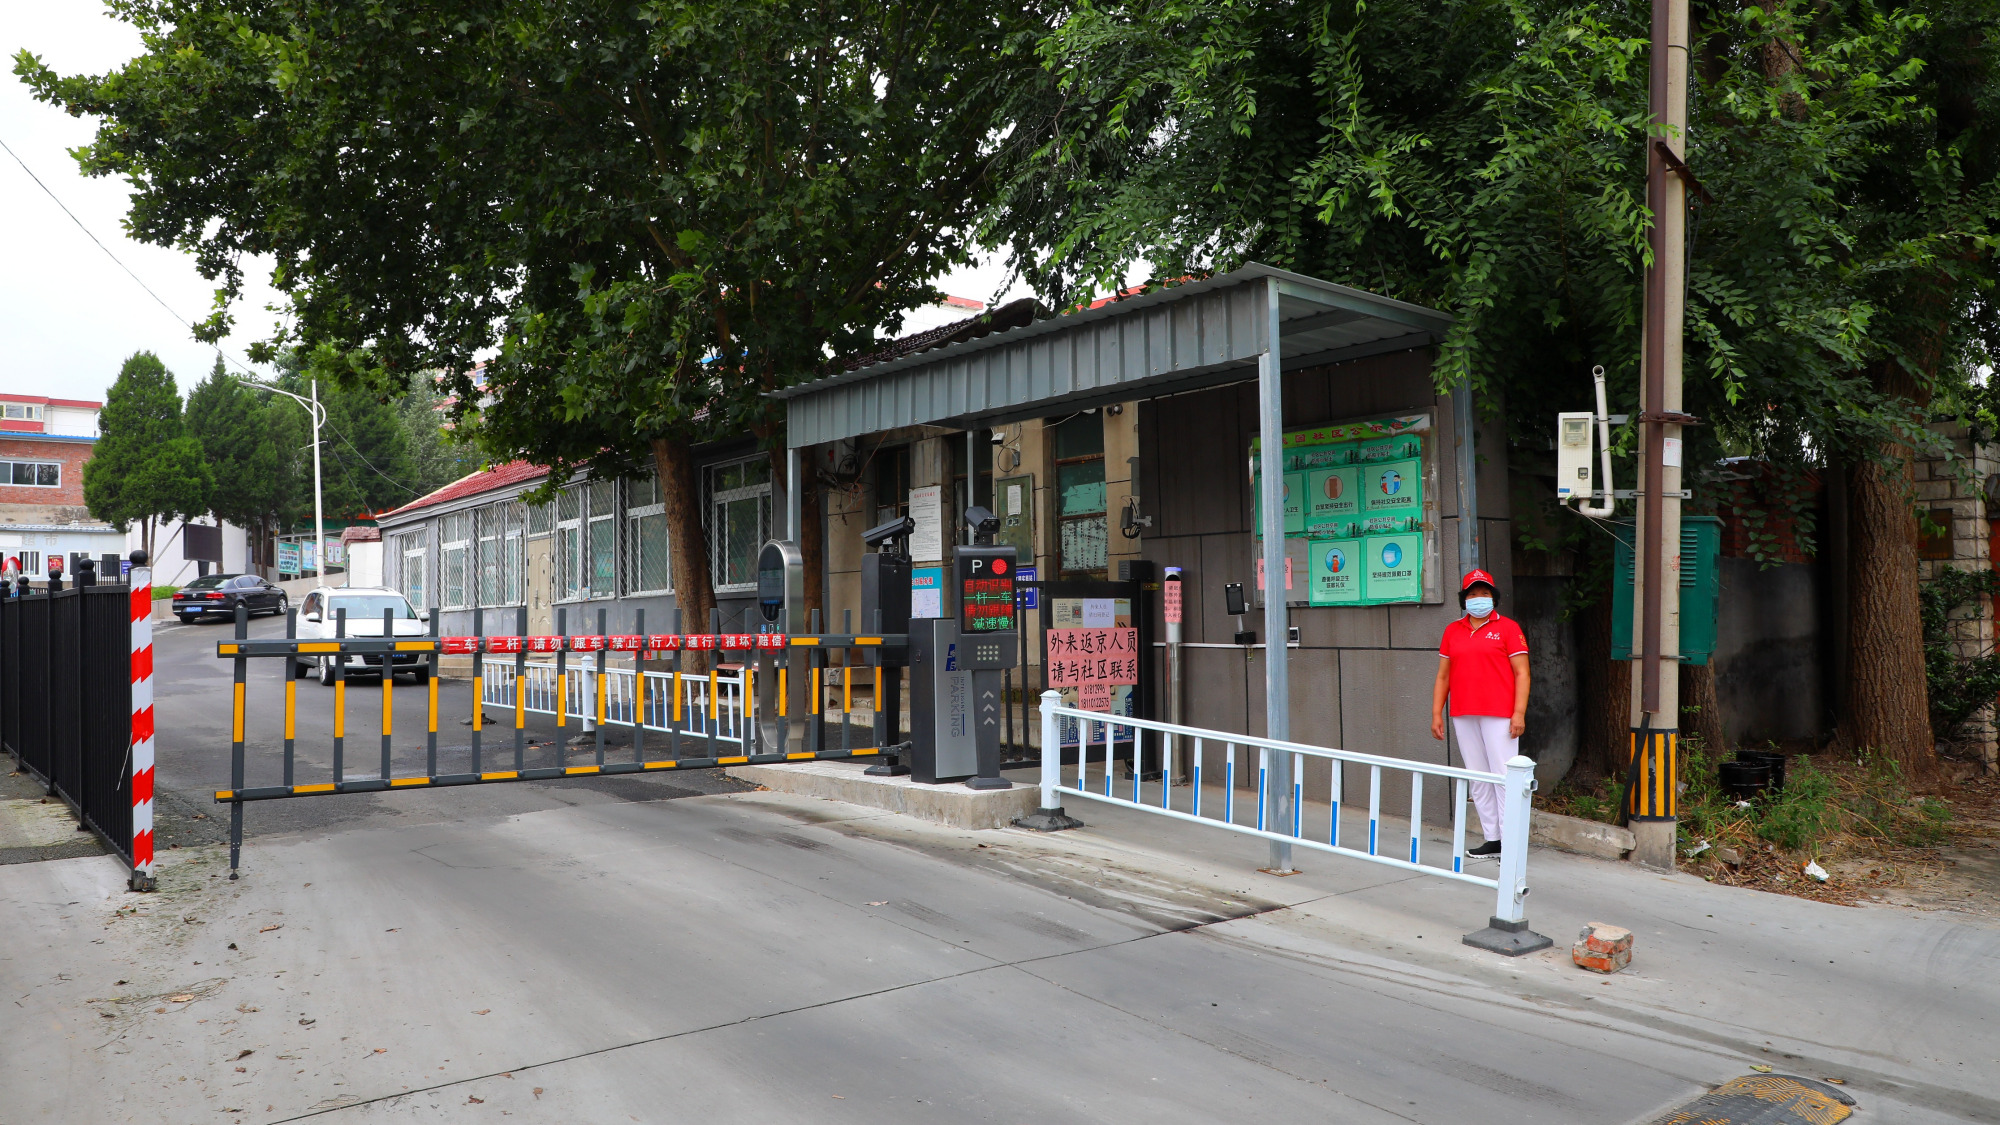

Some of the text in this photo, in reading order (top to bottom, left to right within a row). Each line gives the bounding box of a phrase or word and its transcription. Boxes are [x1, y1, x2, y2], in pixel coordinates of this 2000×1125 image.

[972, 560, 982, 573] P
[965, 579, 1012, 592] 自动识别
[964, 591, 1012, 604] 一杆一车
[964, 604, 1013, 617] 请勿跟随
[1051, 631, 1136, 654] 外来返京人员
[1051, 659, 1136, 683] 请与社区联系
[950, 676, 960, 738] PARKING
